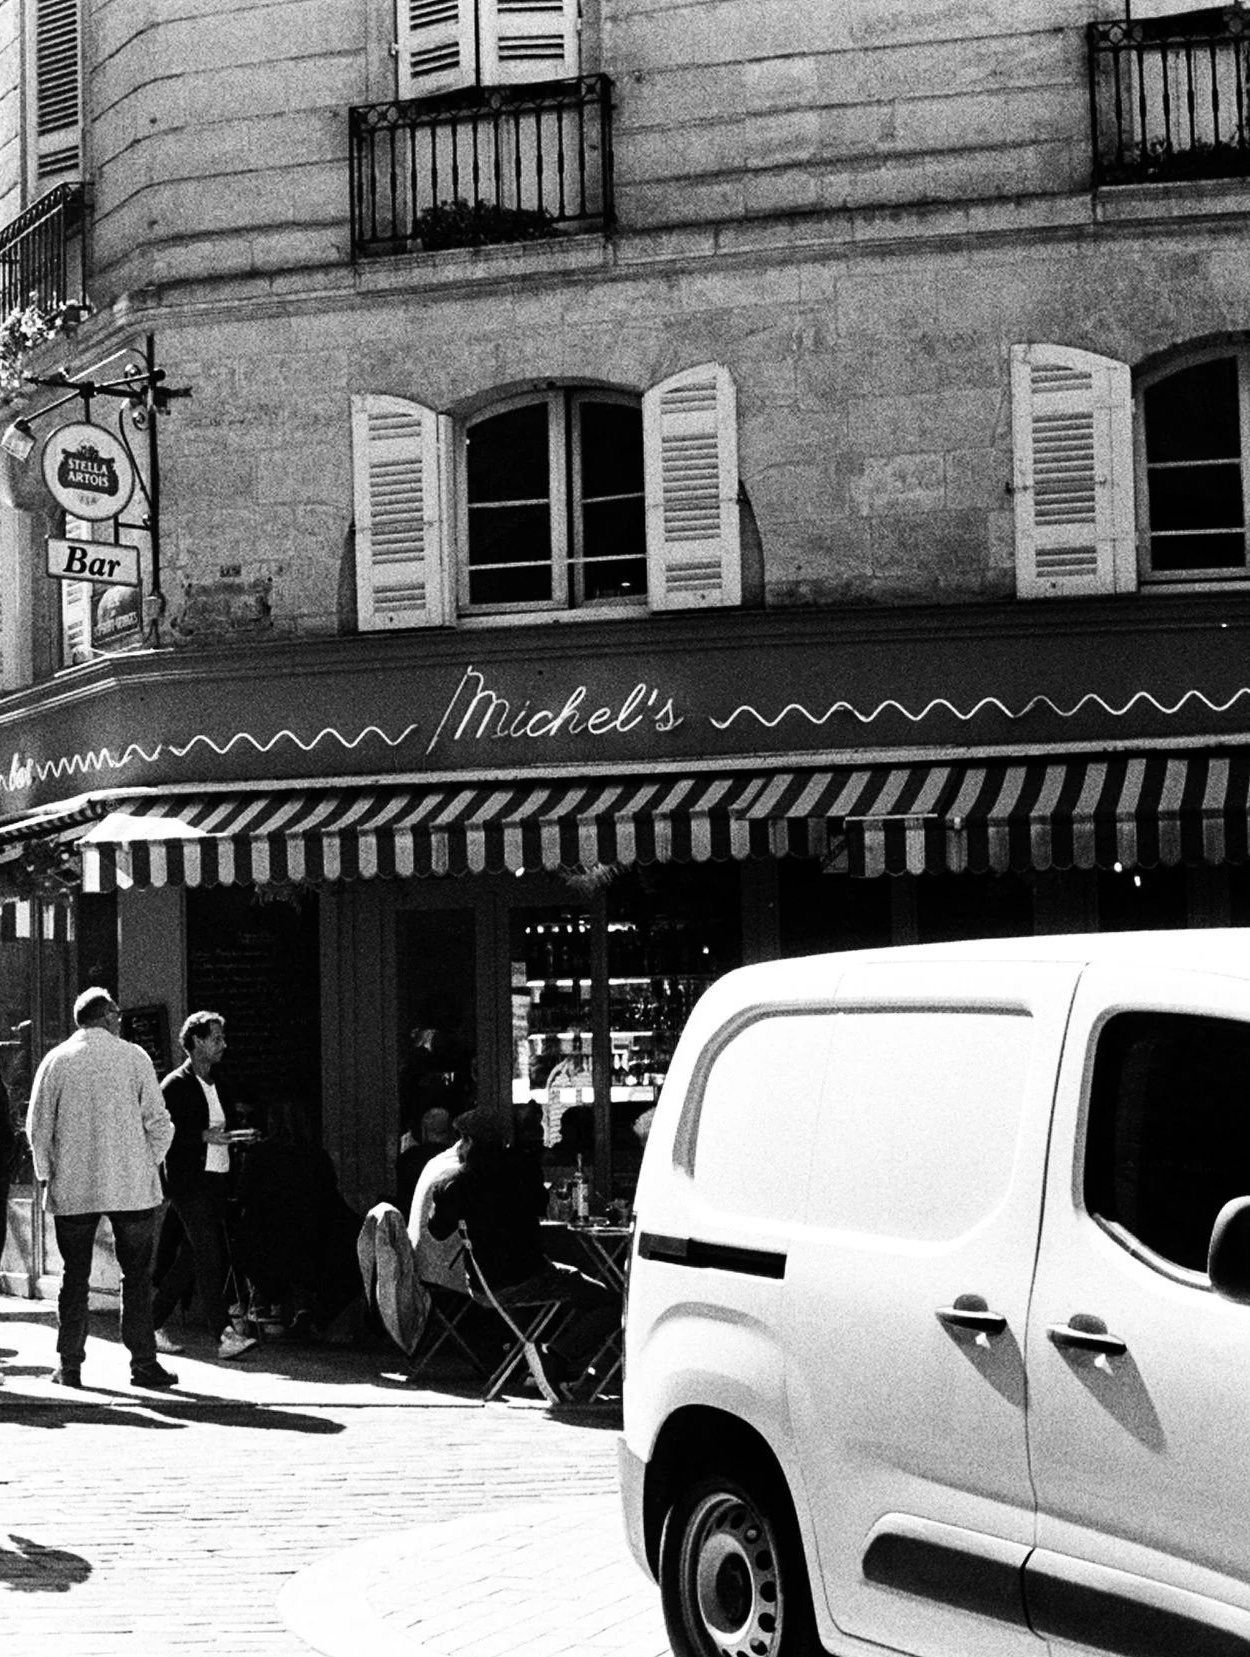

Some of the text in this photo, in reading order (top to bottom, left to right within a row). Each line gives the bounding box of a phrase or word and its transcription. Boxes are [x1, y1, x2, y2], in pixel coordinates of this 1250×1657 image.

[67, 457, 109, 476] STELLA
[67, 470, 110, 488] ARTOIS
[62, 545, 121, 578] Bar
[425, 664, 685, 755] Michel's
